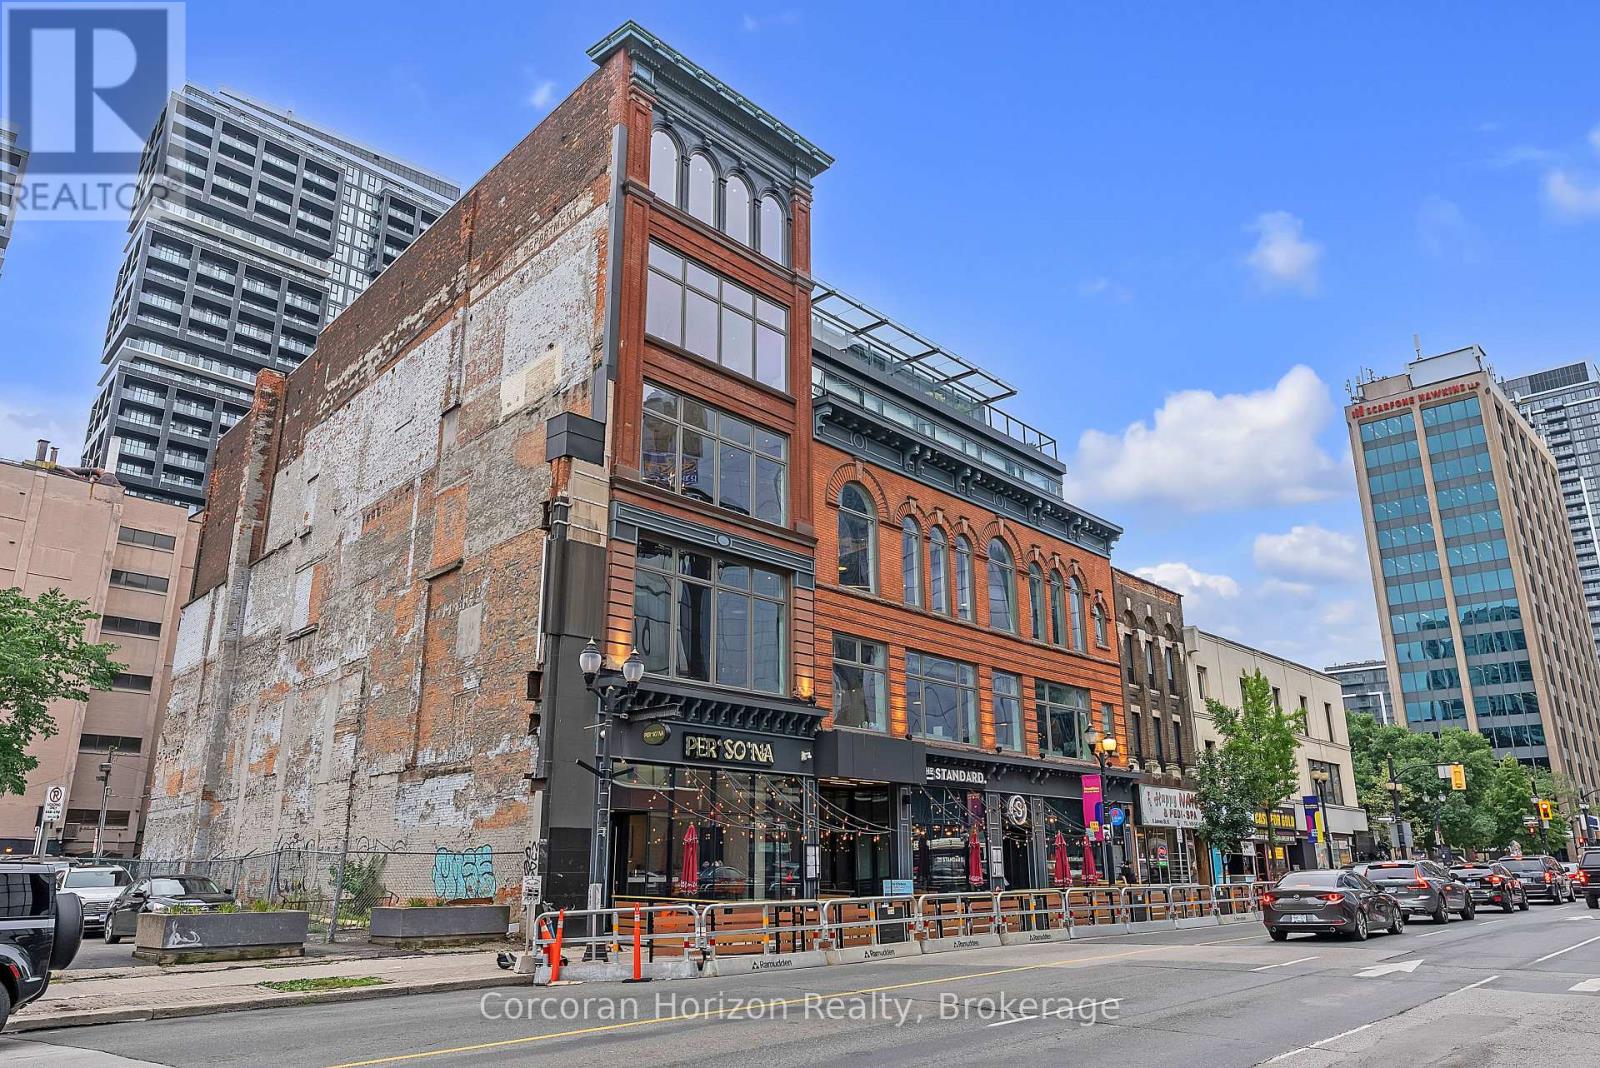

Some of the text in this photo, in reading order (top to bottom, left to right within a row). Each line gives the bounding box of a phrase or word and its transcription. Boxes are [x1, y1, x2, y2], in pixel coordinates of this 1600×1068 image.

[523, 207, 579, 257] DEPARTMENT
[1367, 396, 1415, 416] SCARFONE
[1418, 383, 1465, 402] HAWKINS
[1254, 811, 1268, 825] CAS
[1281, 814, 1295, 828] GOLD
[869, 947, 896, 958] Ramudden
[759, 959, 793, 969] Ramudden
